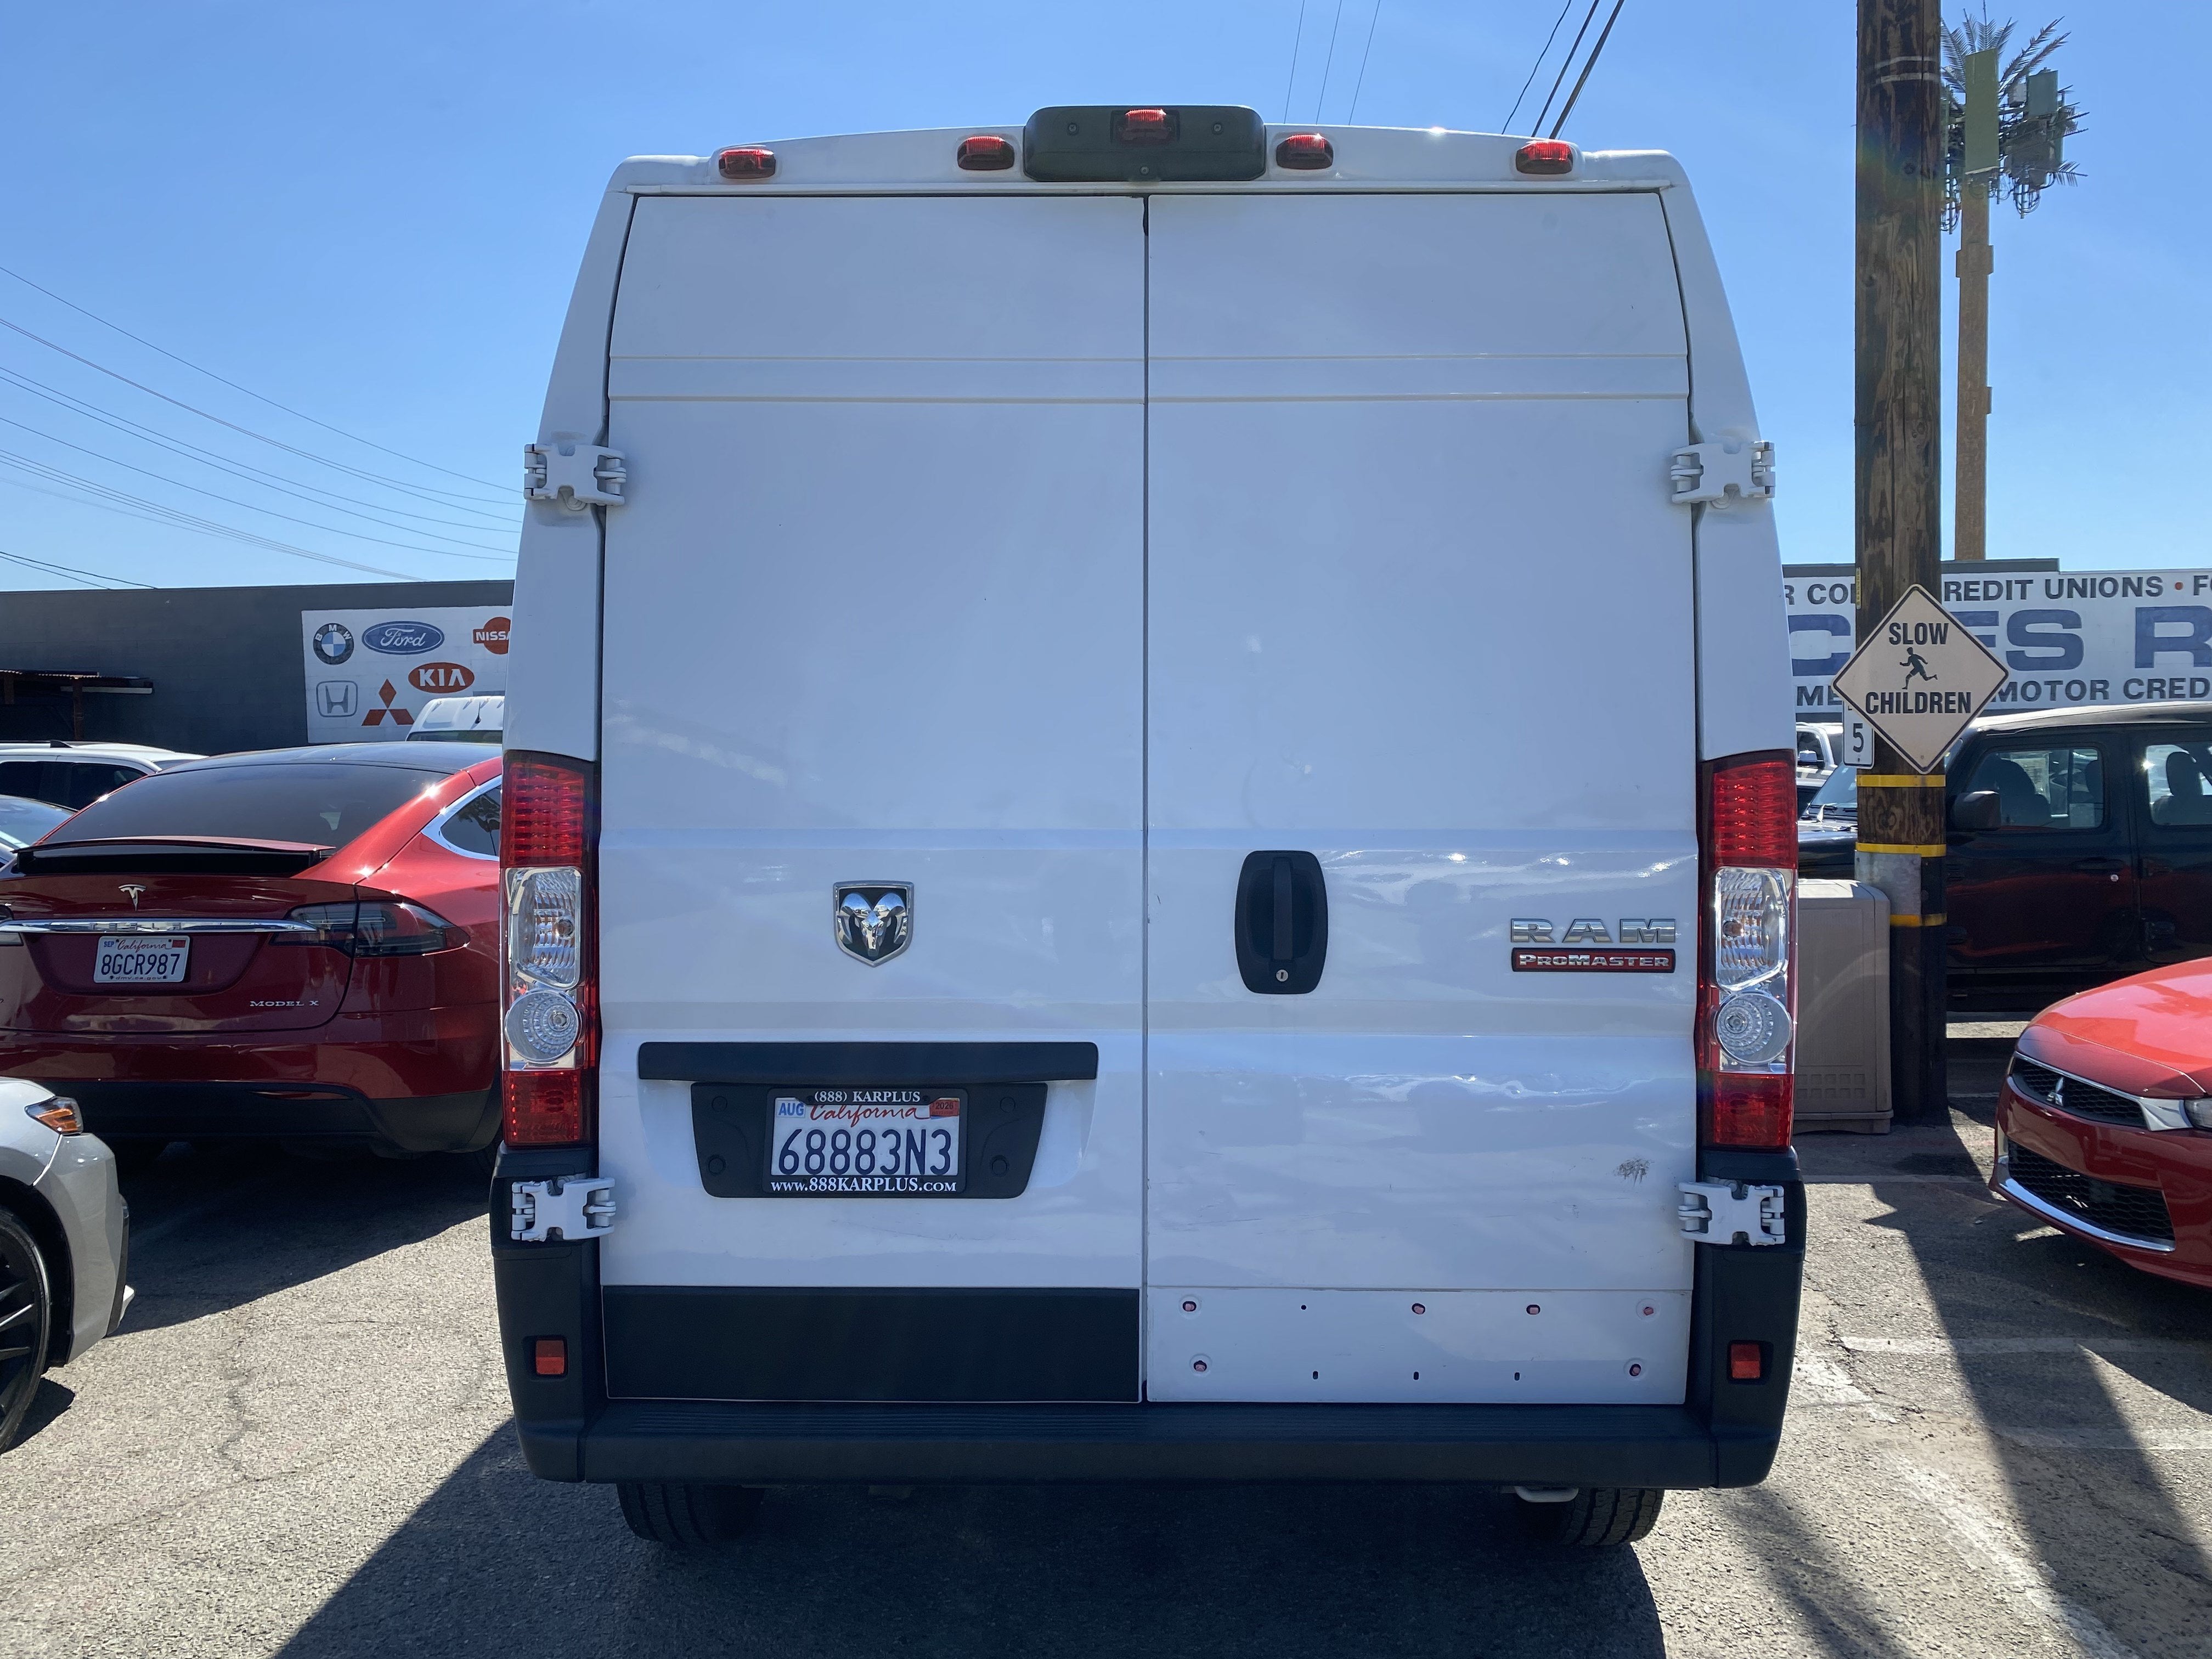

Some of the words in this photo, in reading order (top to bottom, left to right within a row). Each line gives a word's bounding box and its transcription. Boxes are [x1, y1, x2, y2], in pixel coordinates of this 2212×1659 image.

[2045, 576, 2164, 600] UNIONS
[315, 624, 352, 641] BMW
[380, 628, 426, 647] Ford
[1889, 622, 1949, 645] SLOW
[419, 669, 466, 686] KIA
[1865, 691, 1972, 714] CHILDREN
[1510, 918, 1676, 943] RAM
[117, 939, 167, 953] California
[101, 953, 180, 975] 8GCR987
[814, 1091, 848, 1102] (888)
[853, 1091, 921, 1102] KARPLUS
[778, 1103, 804, 1116] AUG
[810, 1104, 931, 1128] California
[778, 1129, 951, 1175] 68883N3
